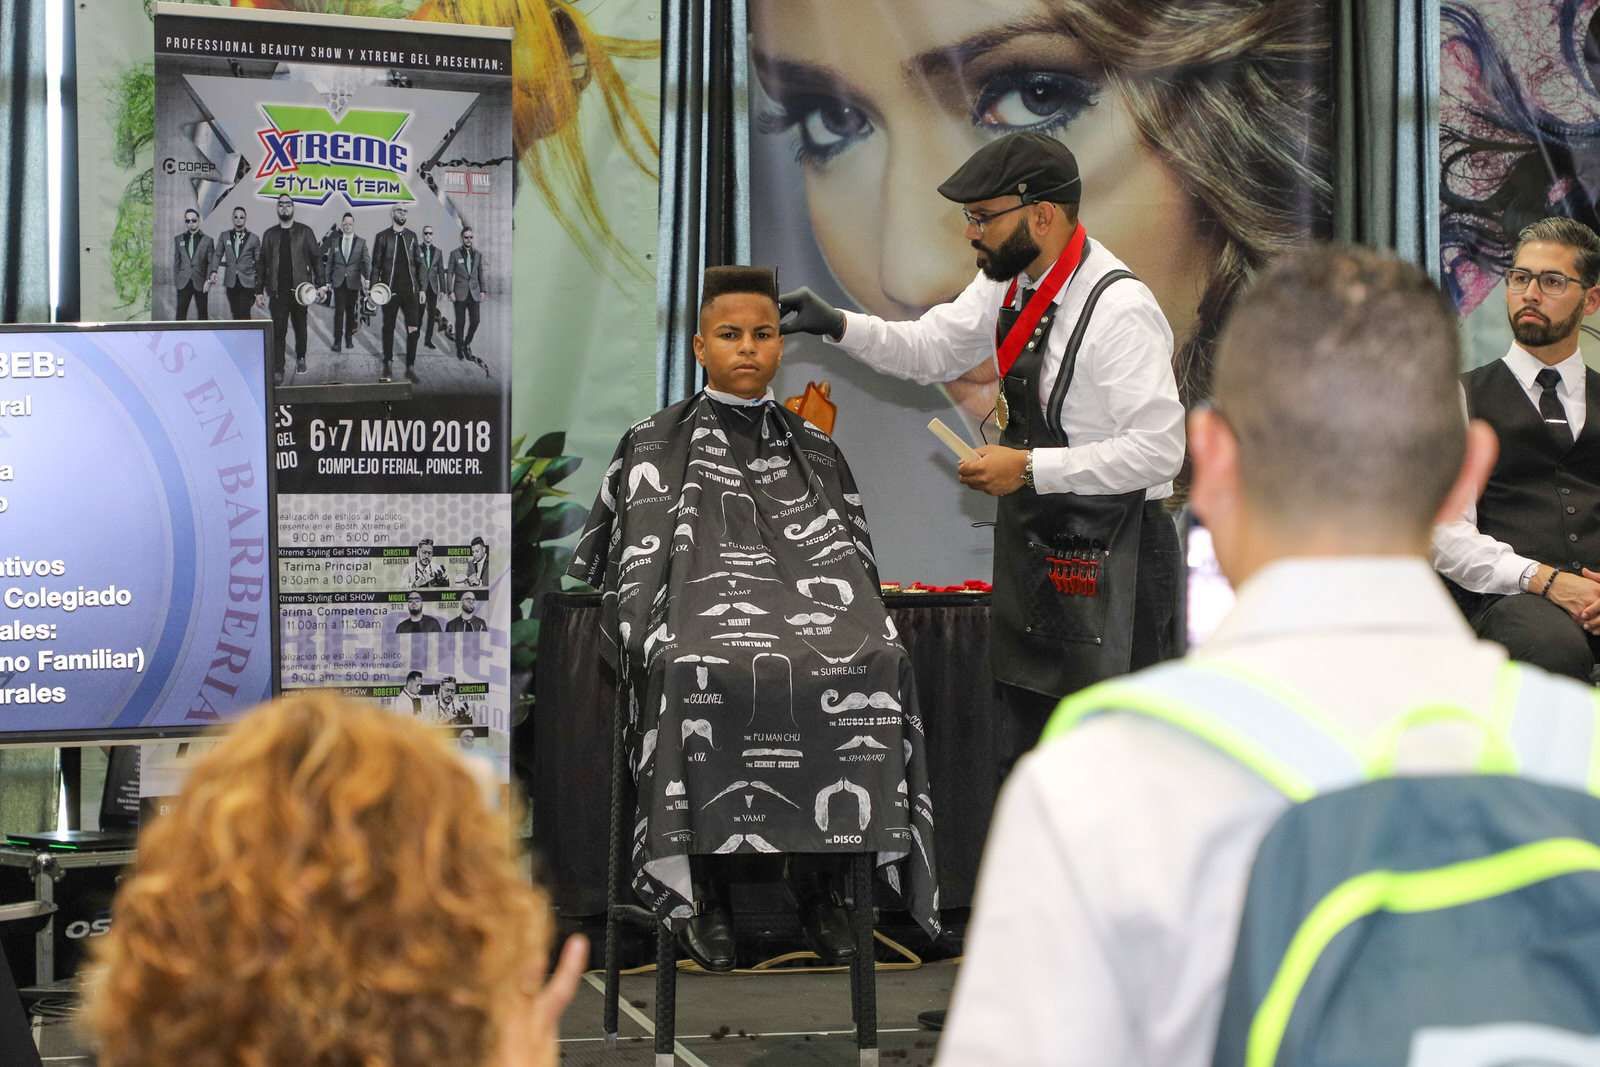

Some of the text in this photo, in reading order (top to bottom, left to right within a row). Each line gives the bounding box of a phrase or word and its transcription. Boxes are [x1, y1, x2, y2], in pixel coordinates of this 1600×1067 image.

[166, 36, 504, 71] PROFESSIONAL BEAUTY SHOW Y XTREME GEL PRESENTAN:
[256, 129, 409, 178] XTREME
[178, 161, 216, 173] COPEP
[274, 173, 401, 194] STYLING TEAM
[275, 405, 293, 427] S
[277, 431, 297, 447] GEL
[360, 420, 426, 452] MAYO
[432, 420, 491, 452] 2018
[634, 443, 662, 453] PENCIL
[808, 453, 834, 467] PENCIL
[318, 457, 483, 477] COMPLEJO FERIAL, PONCE PR.
[704, 470, 741, 488] STUNTMAN
[774, 469, 788, 480] CHIP
[780, 493, 820, 518] SURREALIST
[322, 513, 332, 521] de
[335, 522, 359, 531] Booth
[361, 522, 391, 531] Xtreme
[320, 534, 335, 543] am
[373, 533, 390, 544] pm
[307, 548, 331, 558] Styling
[332, 547, 345, 556] Gel
[346, 547, 371, 556] SHOW
[383, 548, 410, 557] CHRISTIAN
[447, 547, 471, 557] ROBERTO
[284, 561, 372, 573] Tarima Principal
[184, 459, 266, 721] BARBERIA
[727, 589, 752, 597] VAMP
[4, 584, 132, 612] Colegiado
[307, 594, 333, 604] Styling
[334, 593, 348, 602] Gel
[349, 593, 375, 602] SHOW
[441, 592, 457, 601] MARC
[317, 606, 388, 619] Competencia
[727, 618, 751, 627] SHERIFF
[802, 627, 816, 636] MR.
[816, 626, 832, 635] CHIP
[38, 647, 145, 674] Familiar)
[820, 665, 868, 676] SURREALIST
[319, 673, 335, 682] am
[373, 673, 390, 683] pm
[0, 683, 67, 705] rales
[459, 684, 486, 694] CHRISTIAN
[689, 693, 724, 704] COLONEL
[838, 717, 875, 726] MUSCLE
[876, 716, 903, 726] BEACH
[753, 733, 764, 742] FU
[766, 733, 783, 742] MAN
[784, 733, 800, 742] CHU
[693, 752, 706, 762] OZ
[847, 753, 886, 763] SPANIARD
[778, 760, 800, 768] SWEEPER
[833, 834, 862, 844] DISCO
